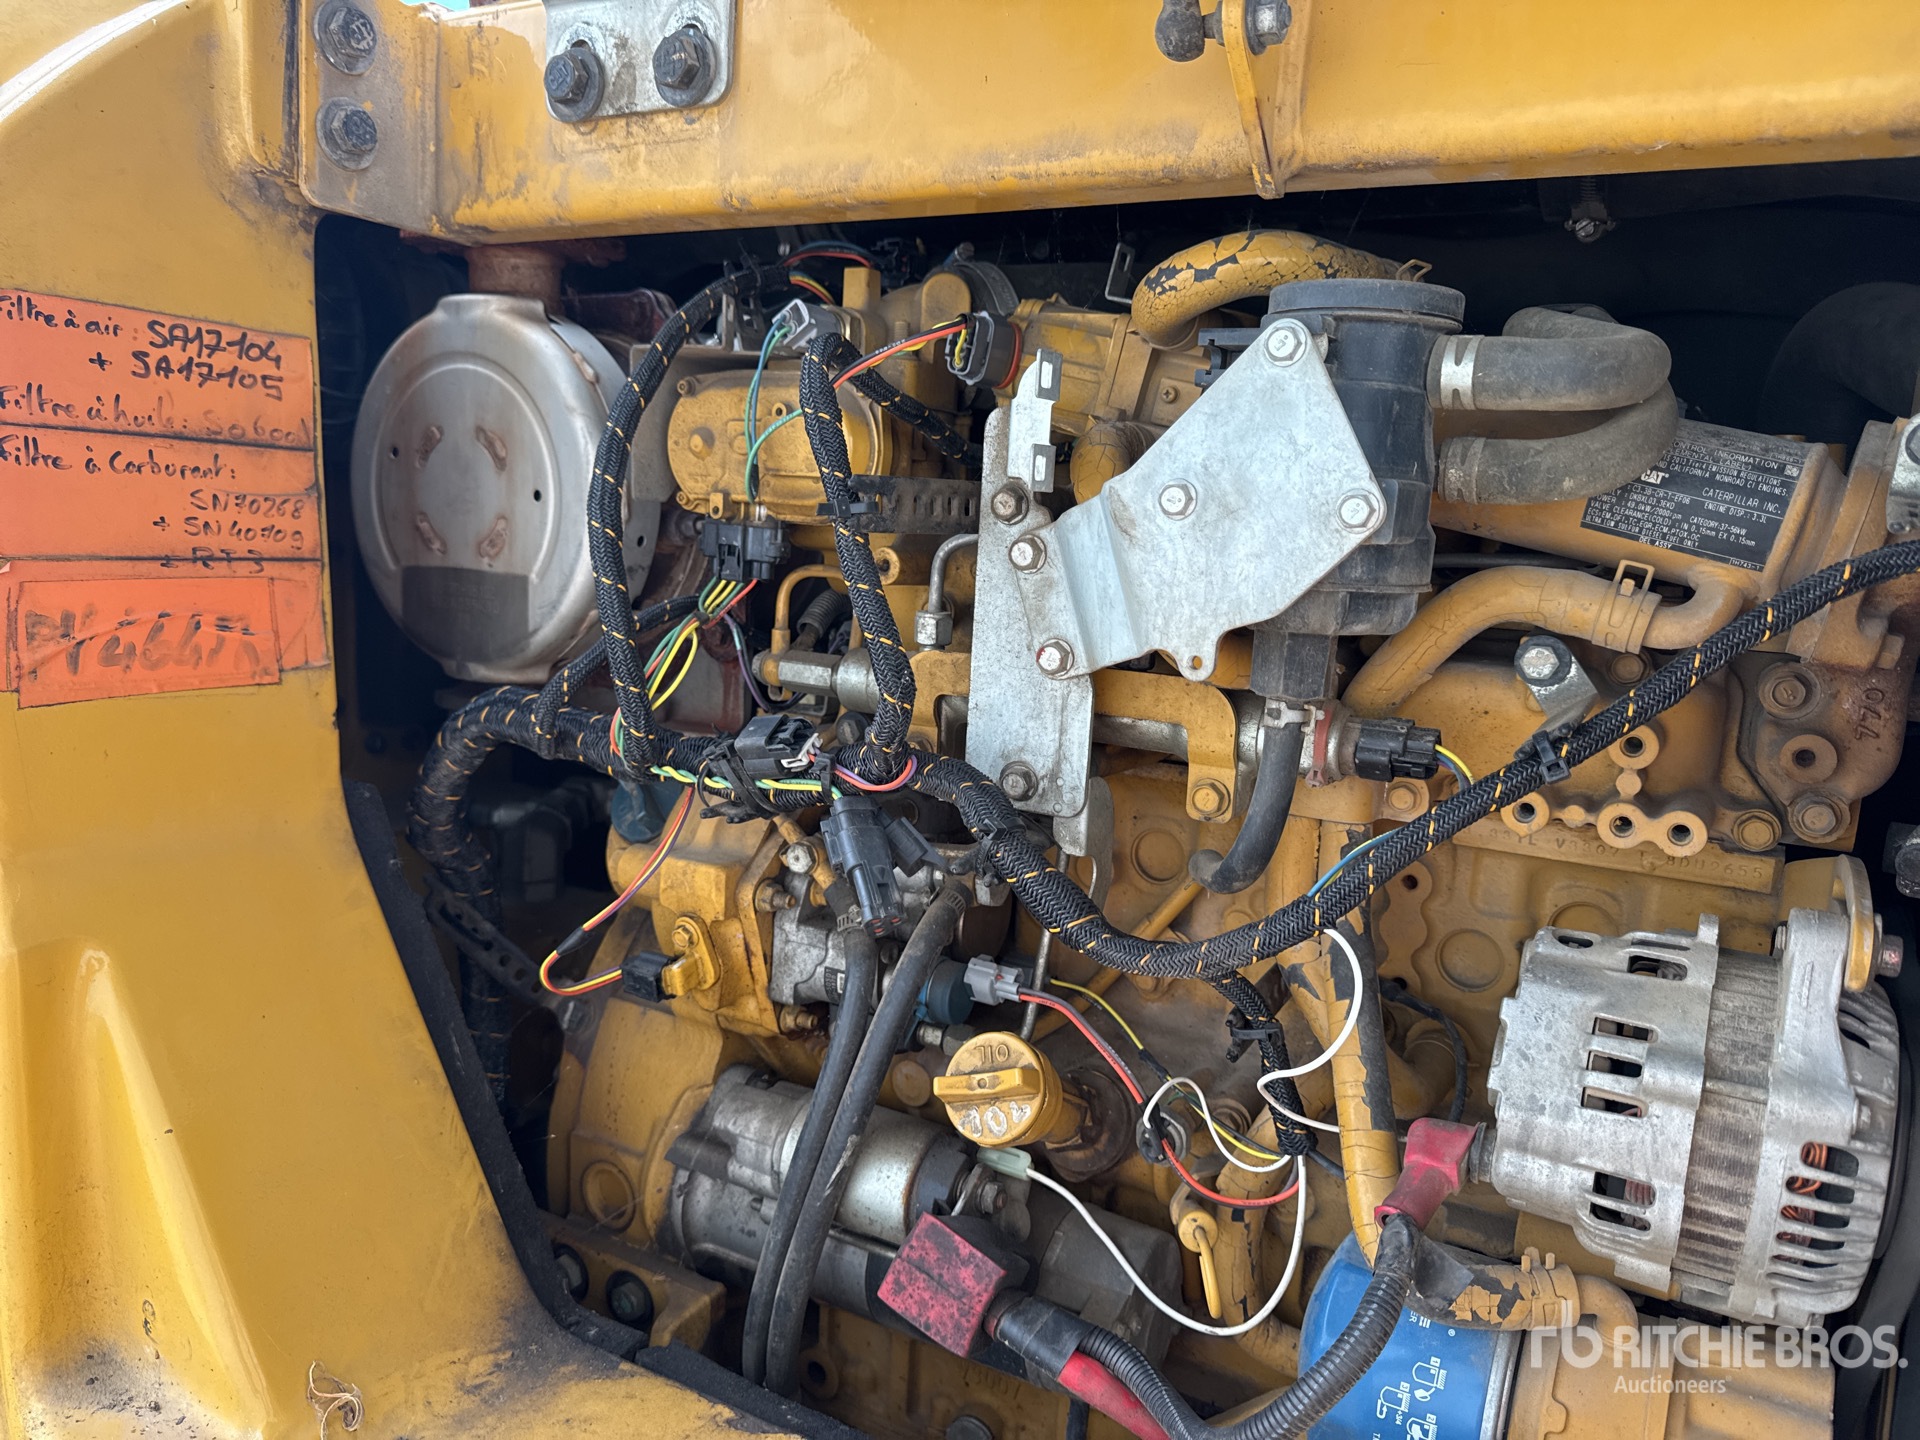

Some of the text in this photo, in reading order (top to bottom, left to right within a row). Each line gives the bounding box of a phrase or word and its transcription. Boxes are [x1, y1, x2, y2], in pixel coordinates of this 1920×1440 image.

[147, 320, 283, 371] SA17104
[130, 350, 284, 402] SA17105
[1714, 449, 1779, 469] INFORMATION
[1669, 463, 1710, 478] CALIFORNIA
[1715, 473, 1745, 486] NONROAD
[1708, 464, 1738, 476] EMISSION
[1739, 471, 1781, 486] REGULATIONS
[1590, 501, 1610, 510] VALVE
[1702, 487, 1782, 513] CATERPILLAR INC.
[1704, 502, 1727, 513] ENGINE
[973, 1043, 1010, 1065] OIL
